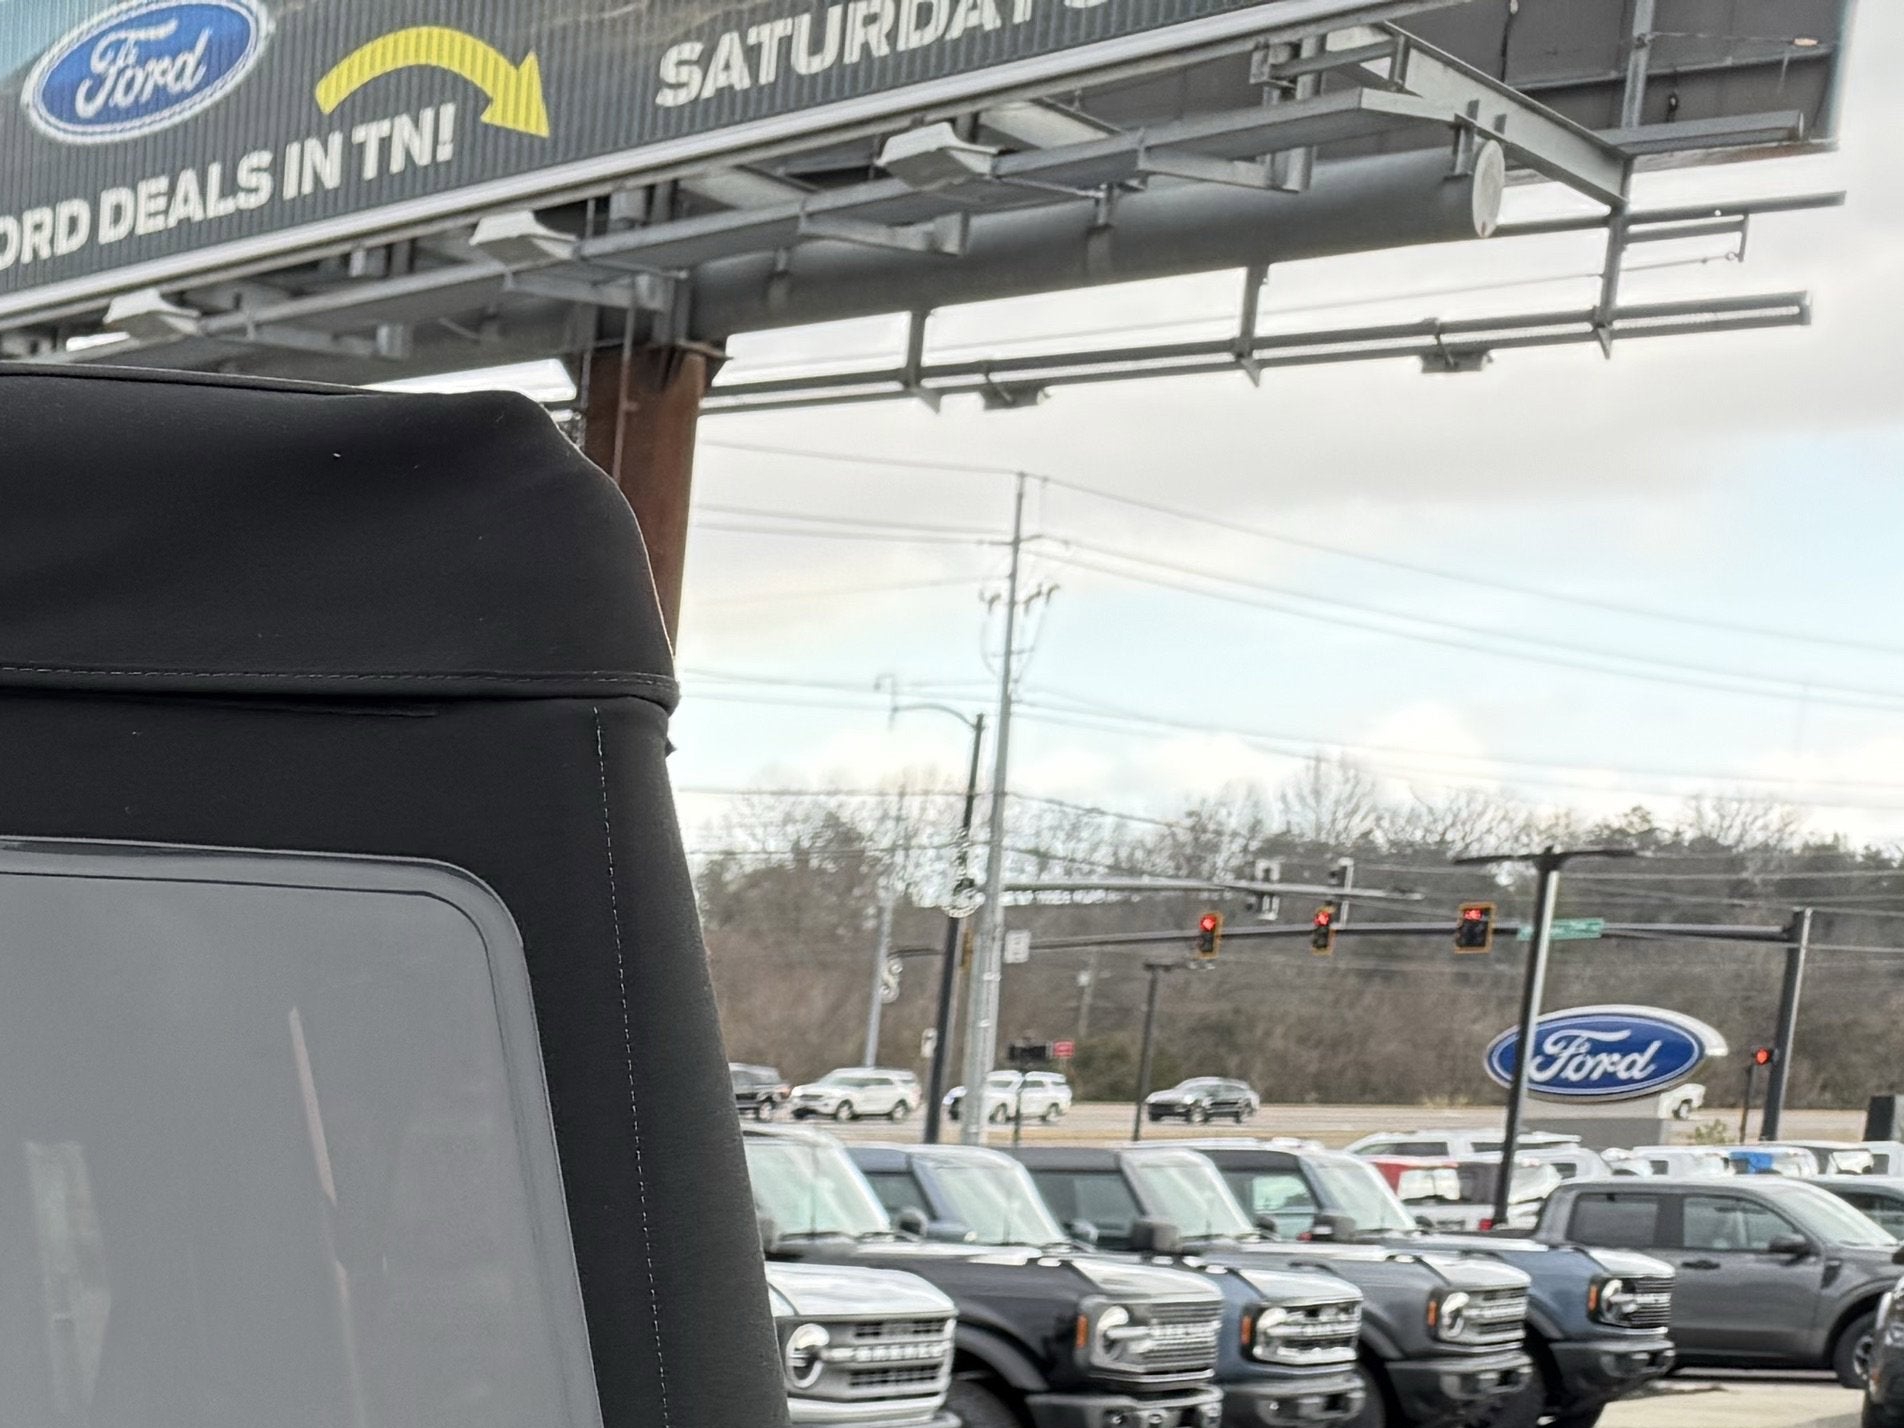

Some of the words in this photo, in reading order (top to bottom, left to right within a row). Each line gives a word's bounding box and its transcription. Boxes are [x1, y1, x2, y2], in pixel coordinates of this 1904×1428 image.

[75, 18, 213, 118] Ford
[98, 150, 273, 245] DEALS
[284, 131, 343, 199] IN
[351, 104, 455, 180] TN!
[1527, 1029, 1662, 1082] Ford
